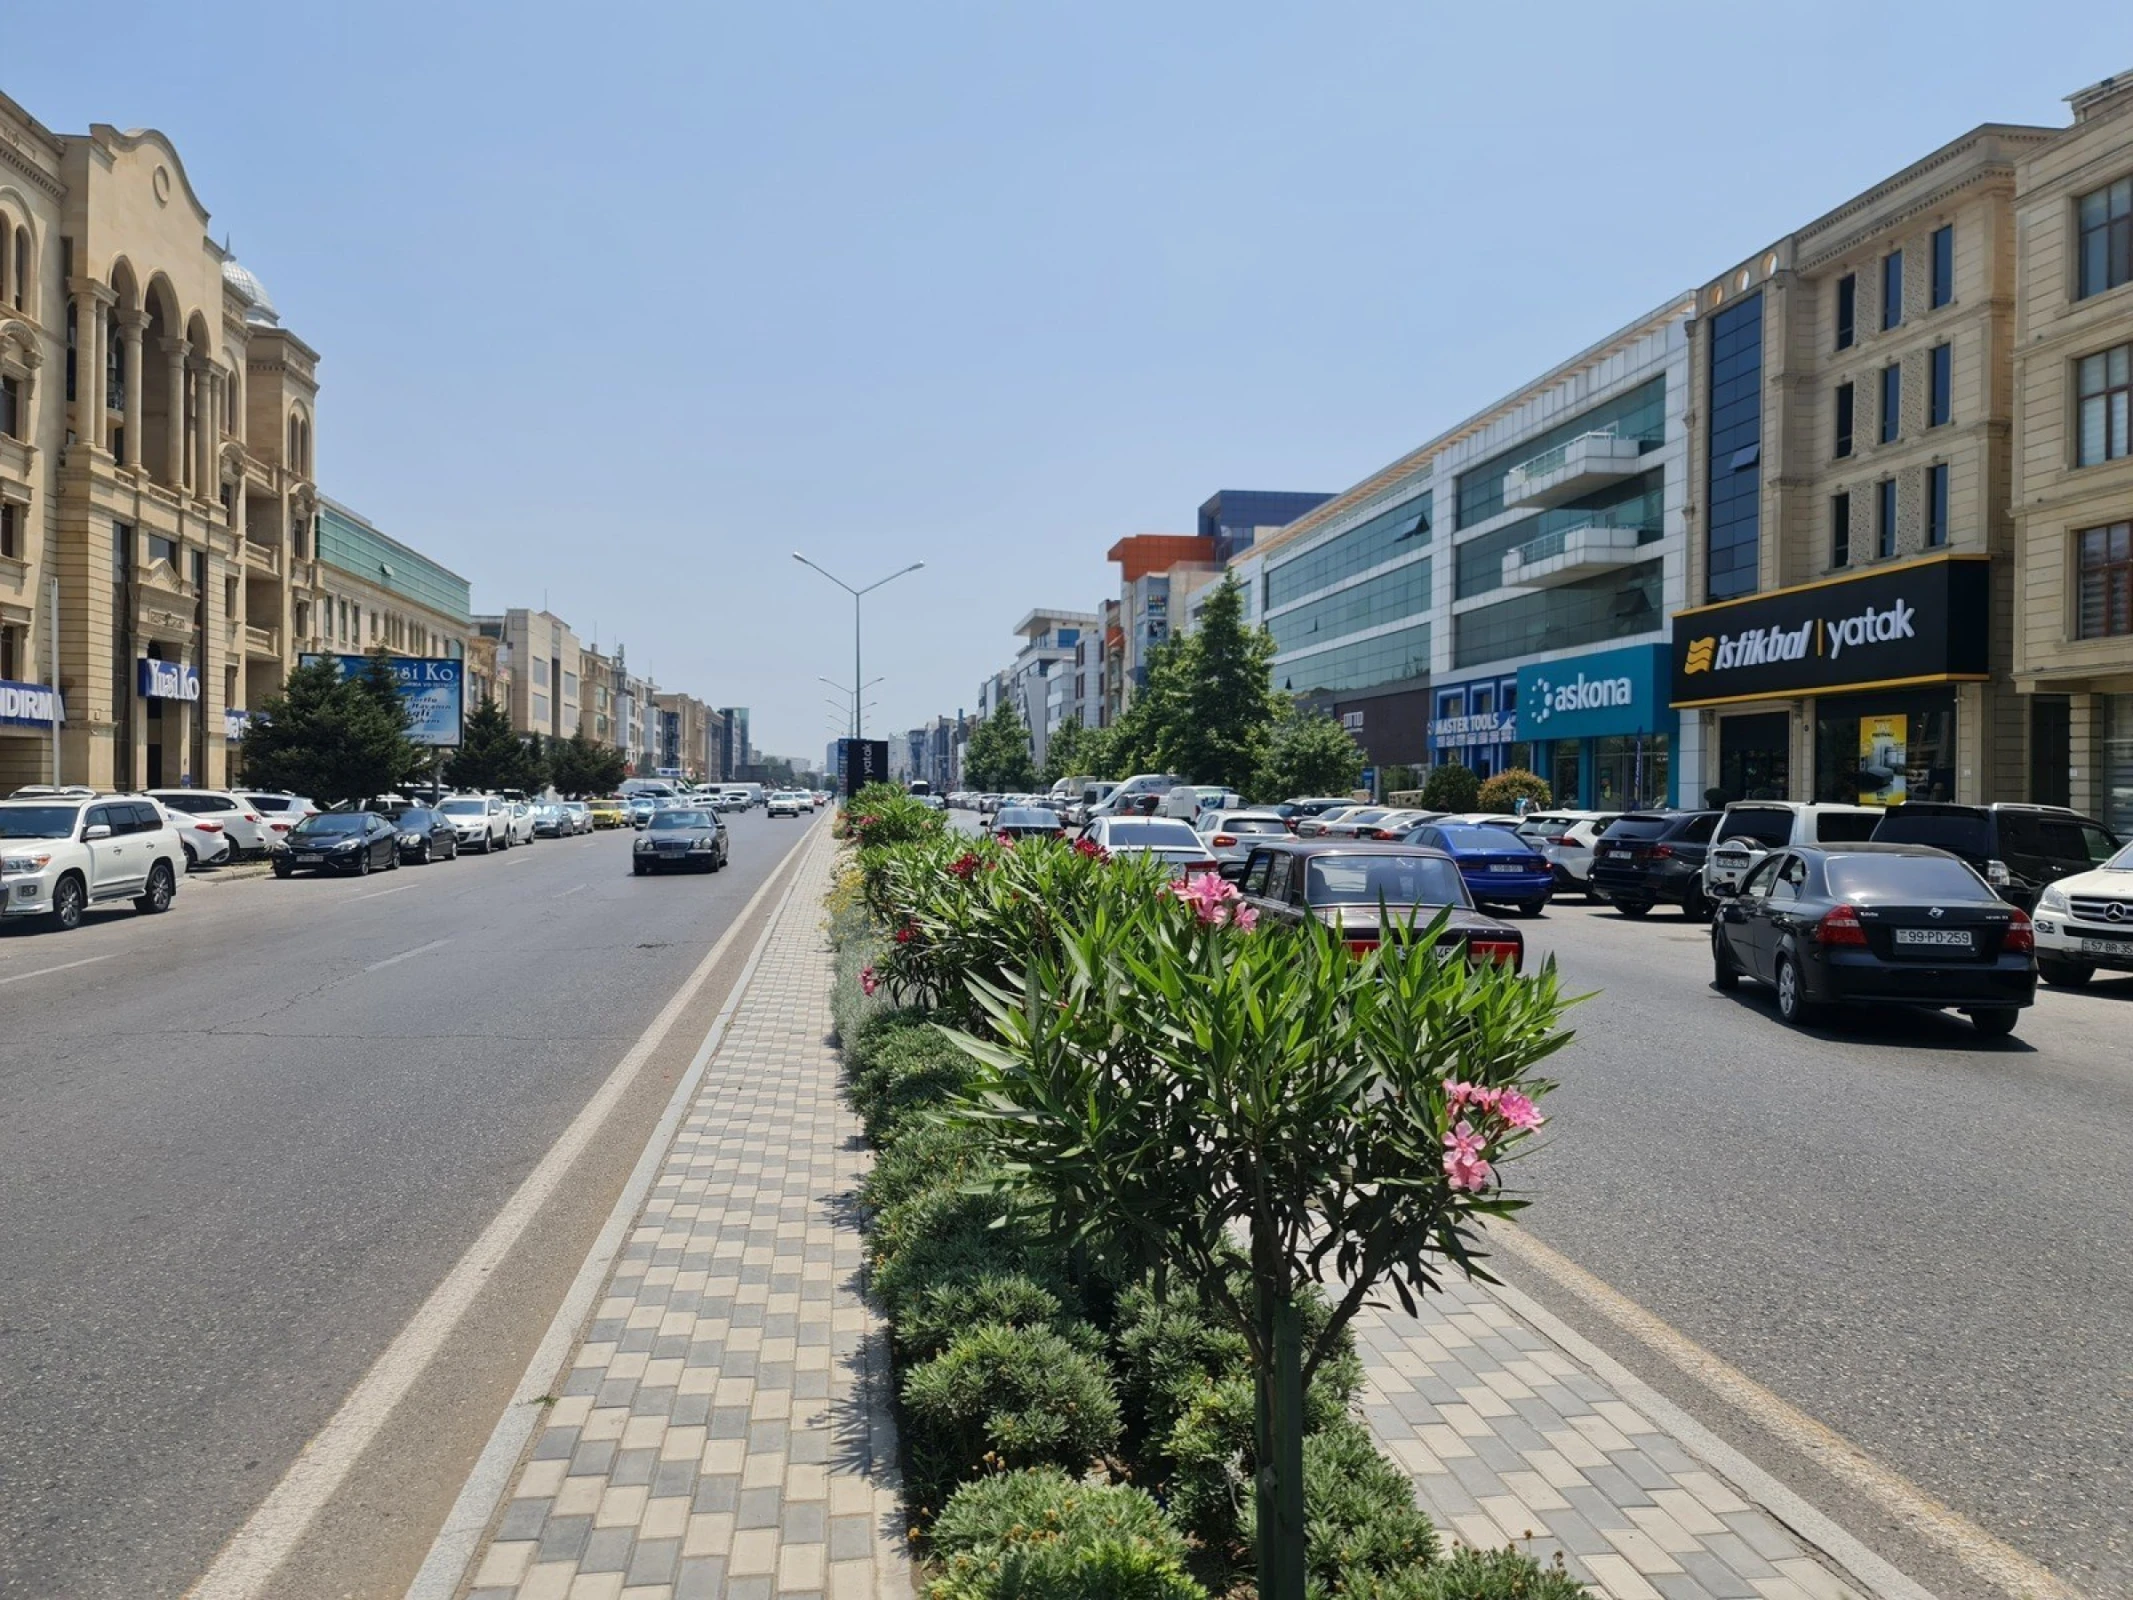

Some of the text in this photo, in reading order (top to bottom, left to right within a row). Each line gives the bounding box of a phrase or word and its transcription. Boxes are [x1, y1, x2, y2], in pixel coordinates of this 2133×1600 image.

[1714, 598, 1915, 670] istikbal yatak
[178, 663, 200, 701] Ko
[388, 663, 454, 681] usi Ko
[1554, 672, 1632, 712] askona
[1434, 712, 1499, 736] MASTER TOOLS
[861, 743, 875, 775] yatak
[1908, 931, 1970, 944] 99-PD-259
